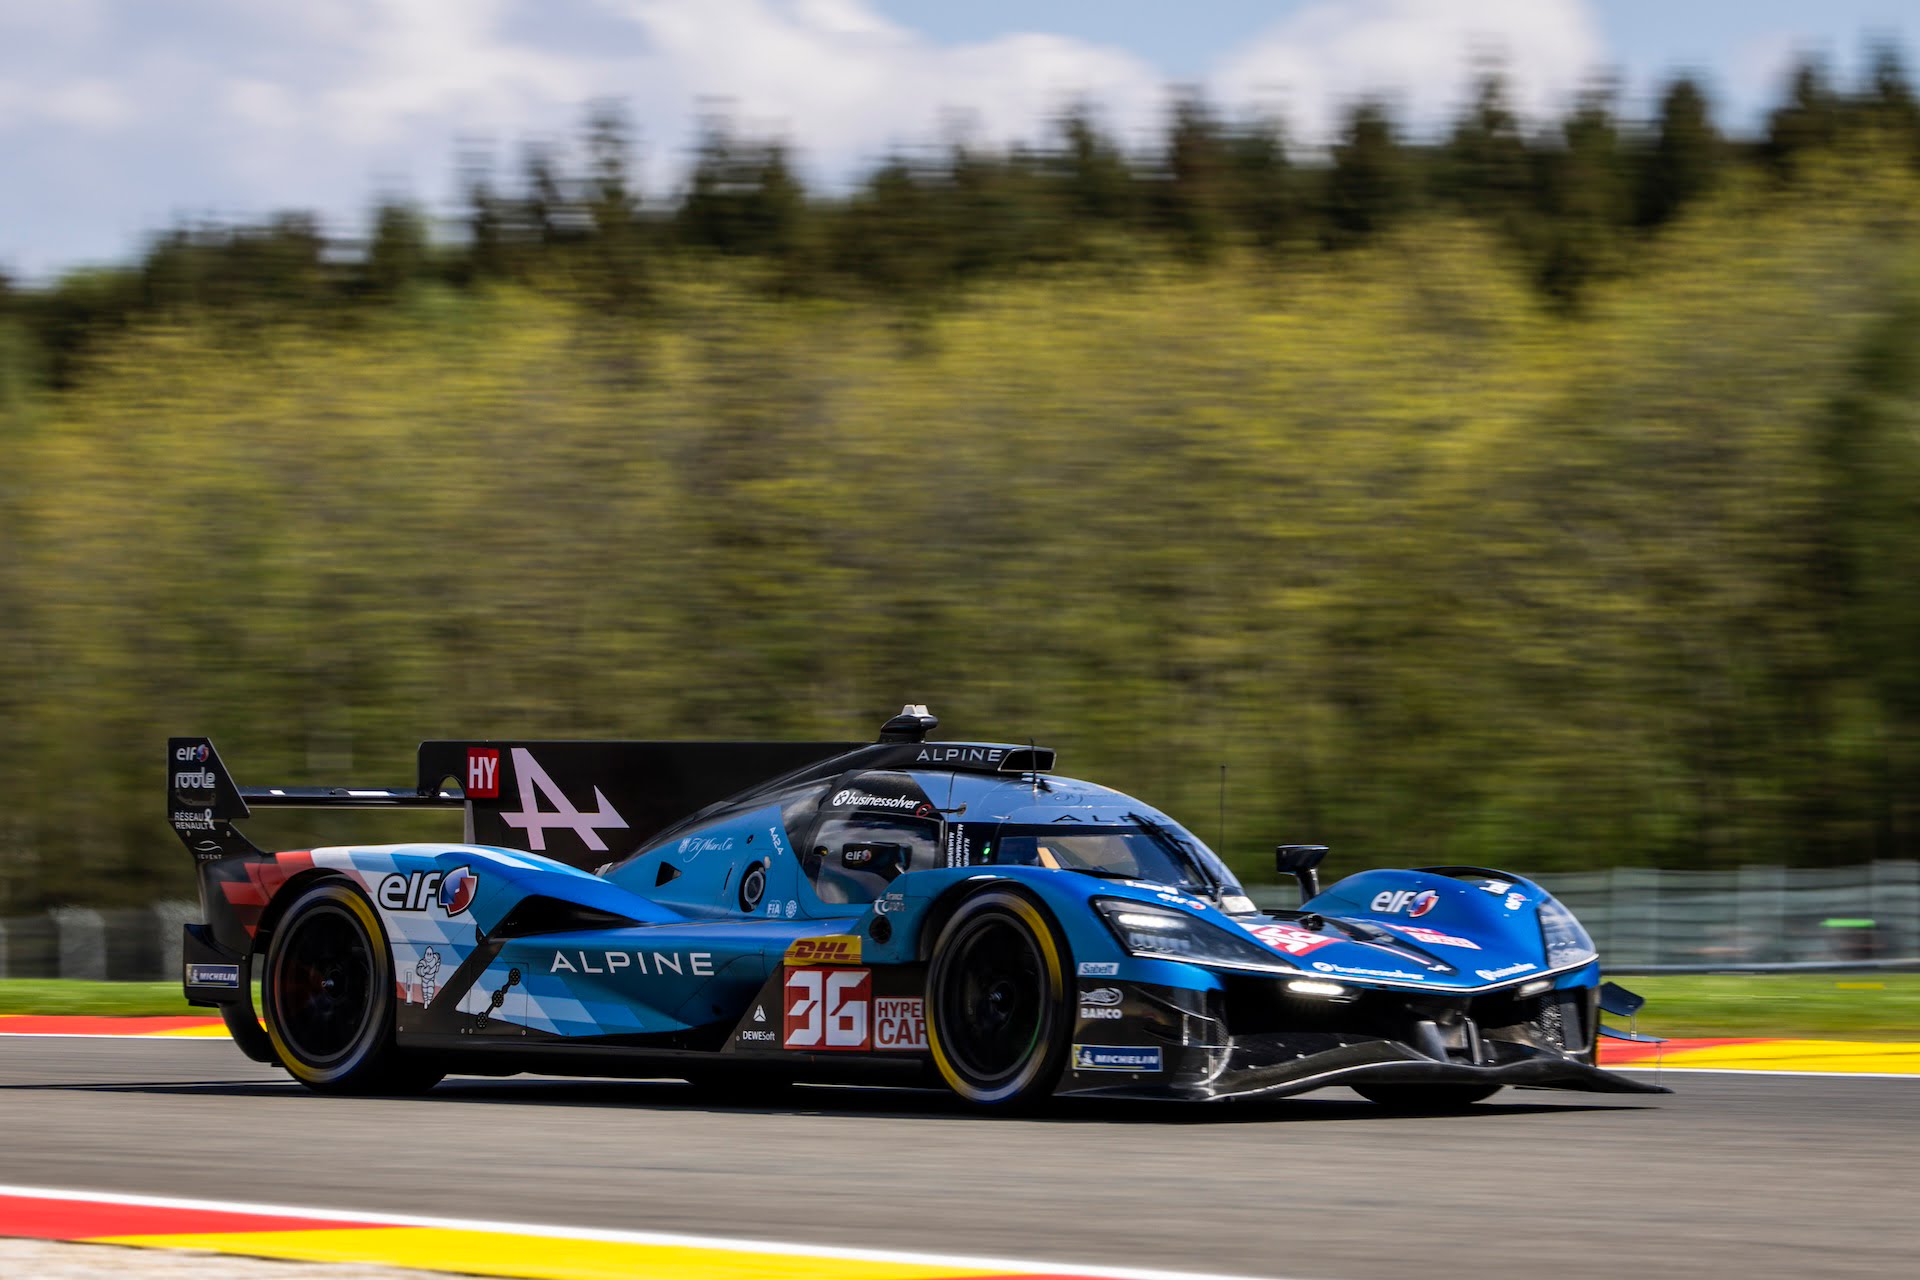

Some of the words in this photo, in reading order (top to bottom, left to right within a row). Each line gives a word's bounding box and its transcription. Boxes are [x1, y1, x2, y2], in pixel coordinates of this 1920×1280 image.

[176, 747, 197, 761] elf
[916, 748, 1003, 762] ALPINE
[175, 766, 215, 789] roole
[469, 756, 497, 789] HY
[845, 792, 921, 810] businessolver
[175, 822, 208, 830] RENAULT
[769, 826, 784, 855] A424
[845, 850, 862, 861] elf
[378, 870, 441, 911] elf
[1370, 890, 1413, 914] elf
[795, 941, 850, 960] DHL
[550, 950, 715, 976] ALPINE
[1082, 963, 1114, 974] Sabelt
[199, 972, 237, 981] MICHELIN
[785, 970, 870, 1046] 36
[1080, 1008, 1123, 1019] BAHCO
[743, 1030, 775, 1041] DEWESoft
[1094, 1054, 1160, 1064] MICHELIN
